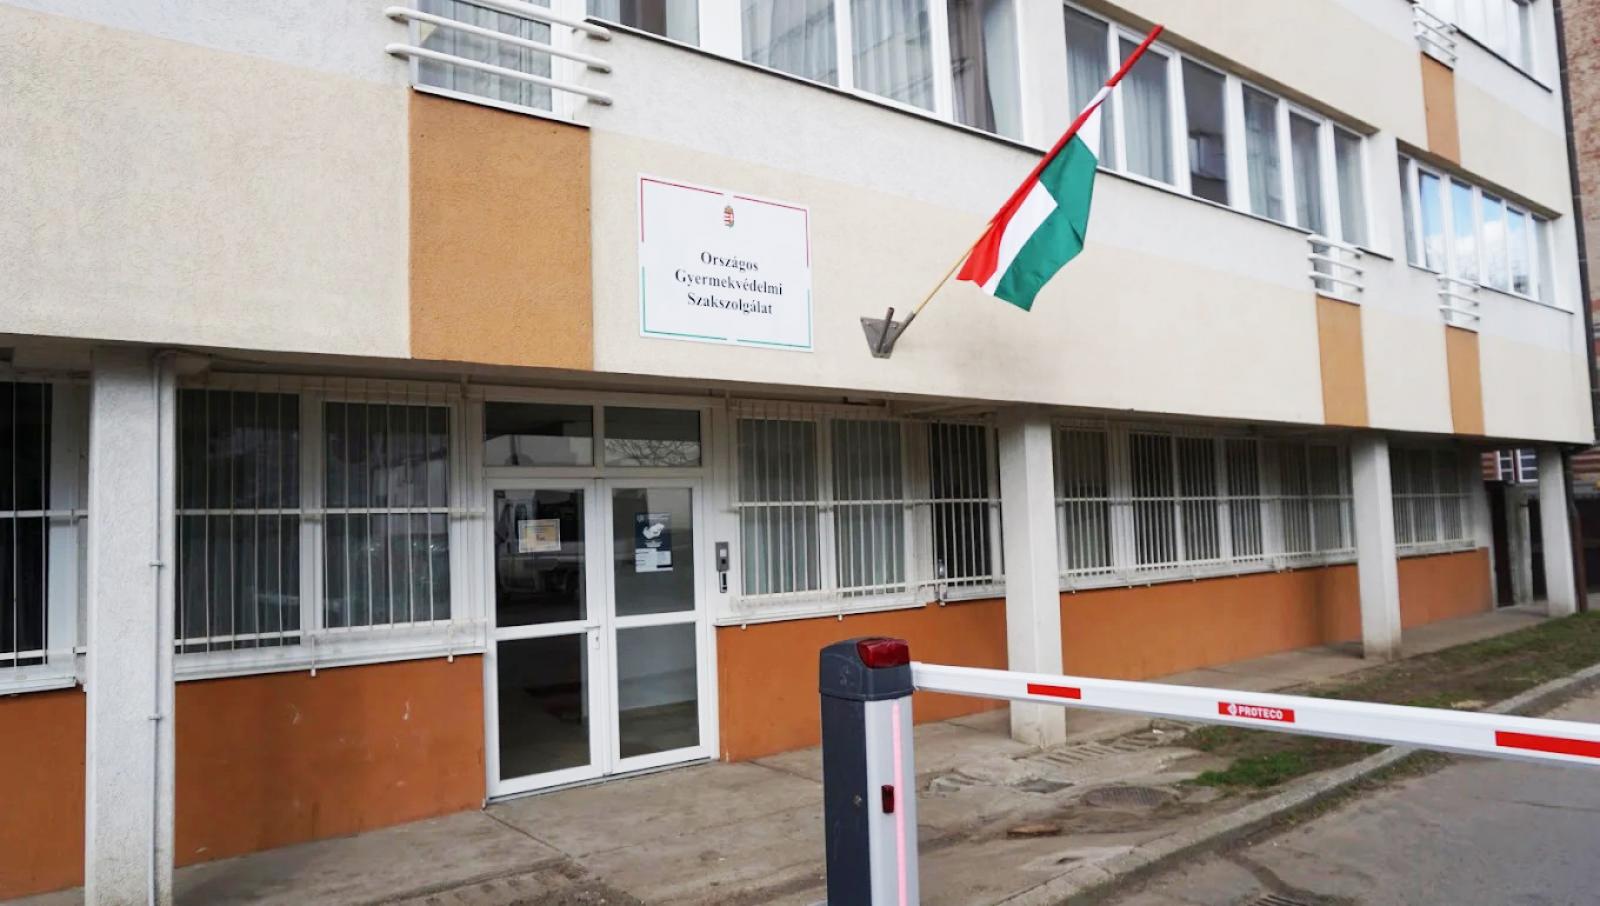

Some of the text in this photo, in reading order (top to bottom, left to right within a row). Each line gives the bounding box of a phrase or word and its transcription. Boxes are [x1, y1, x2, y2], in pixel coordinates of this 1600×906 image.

[700, 251, 759, 272] Országos
[675, 268, 782, 295] Gyermekvédelmi
[687, 292, 773, 314] Szakszolgálat
[1238, 705, 1284, 720] PROTECO
